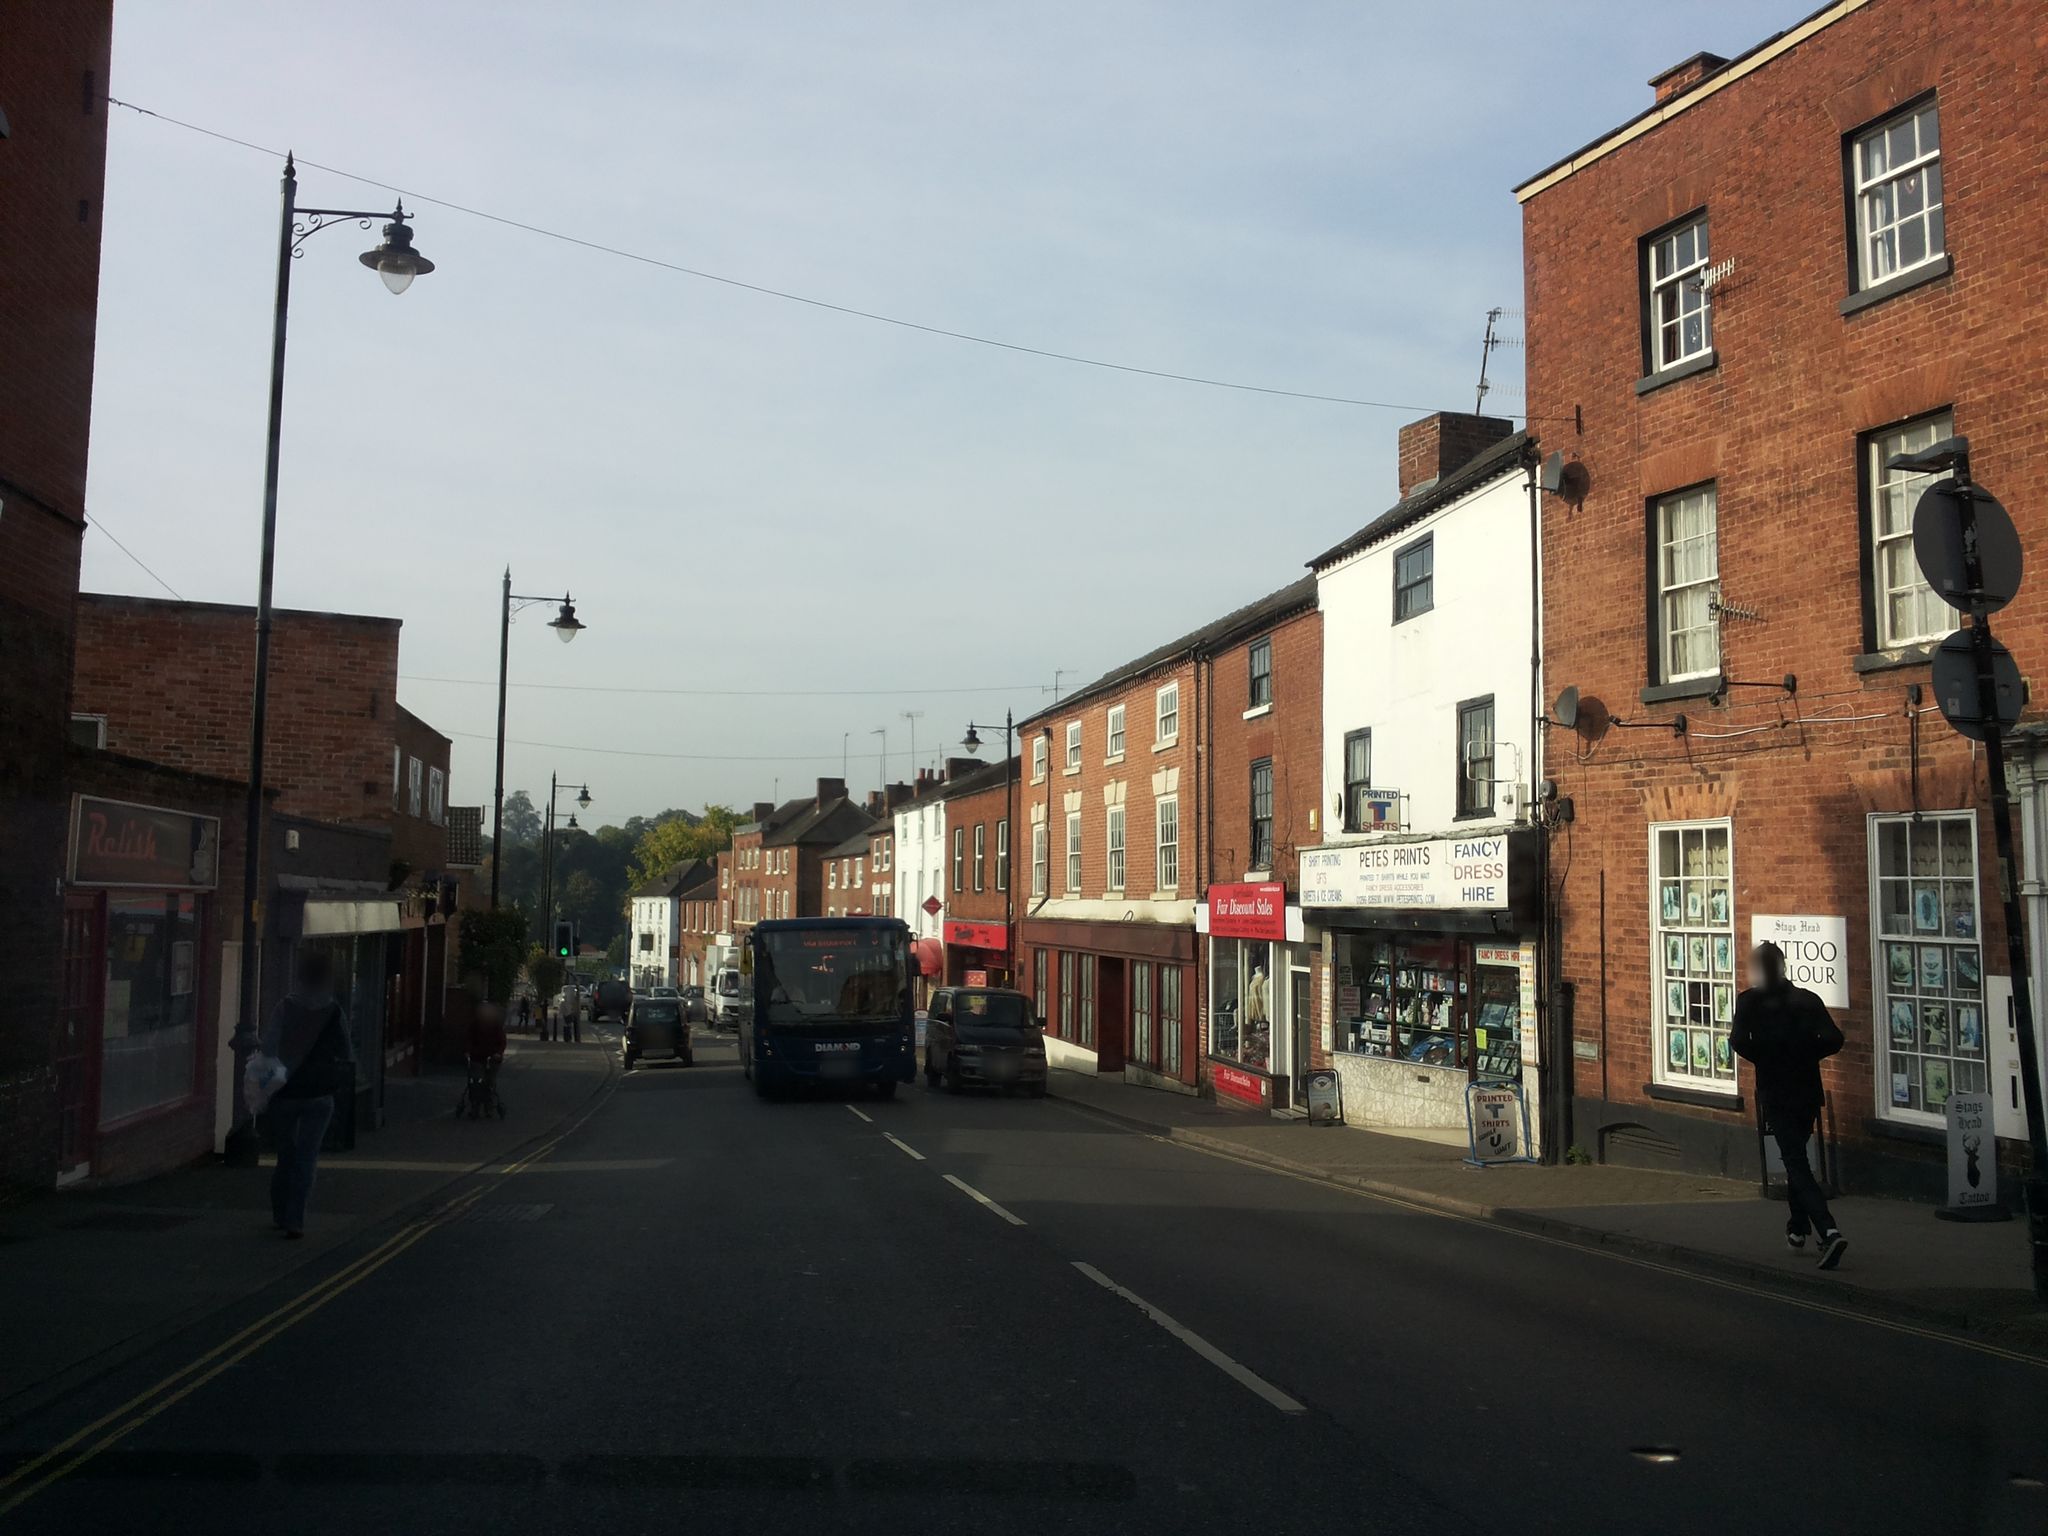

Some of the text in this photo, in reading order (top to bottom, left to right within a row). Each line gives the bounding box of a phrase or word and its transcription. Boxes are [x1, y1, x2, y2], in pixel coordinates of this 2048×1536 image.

[1362, 790, 1398, 799] PRINTED
[1367, 801, 1392, 821] T
[1362, 821, 1398, 831] SHIRTS
[1454, 841, 1502, 859] FANCY
[1359, 846, 1431, 868] PETES PRINTS
[1454, 863, 1504, 880] DRESS
[1462, 886, 1495, 902] HIRE
[1216, 898, 1273, 915] Fair Discount Sales
[1775, 919, 1797, 934] Stags
[1478, 949, 1493, 959] FANCY
[1494, 950, 1509, 960] DRESS
[1760, 940, 1837, 962] TTOO
[815, 1041, 861, 1052] DIAMOND
[1485, 1104, 1504, 1118] T
[1955, 1101, 1983, 1114] Stags
[1481, 1120, 1510, 1128] SHIRTS
[1958, 1116, 1982, 1129] Head
[1490, 1134, 1501, 1147] U
[1959, 1192, 1990, 1205] Tattoo
